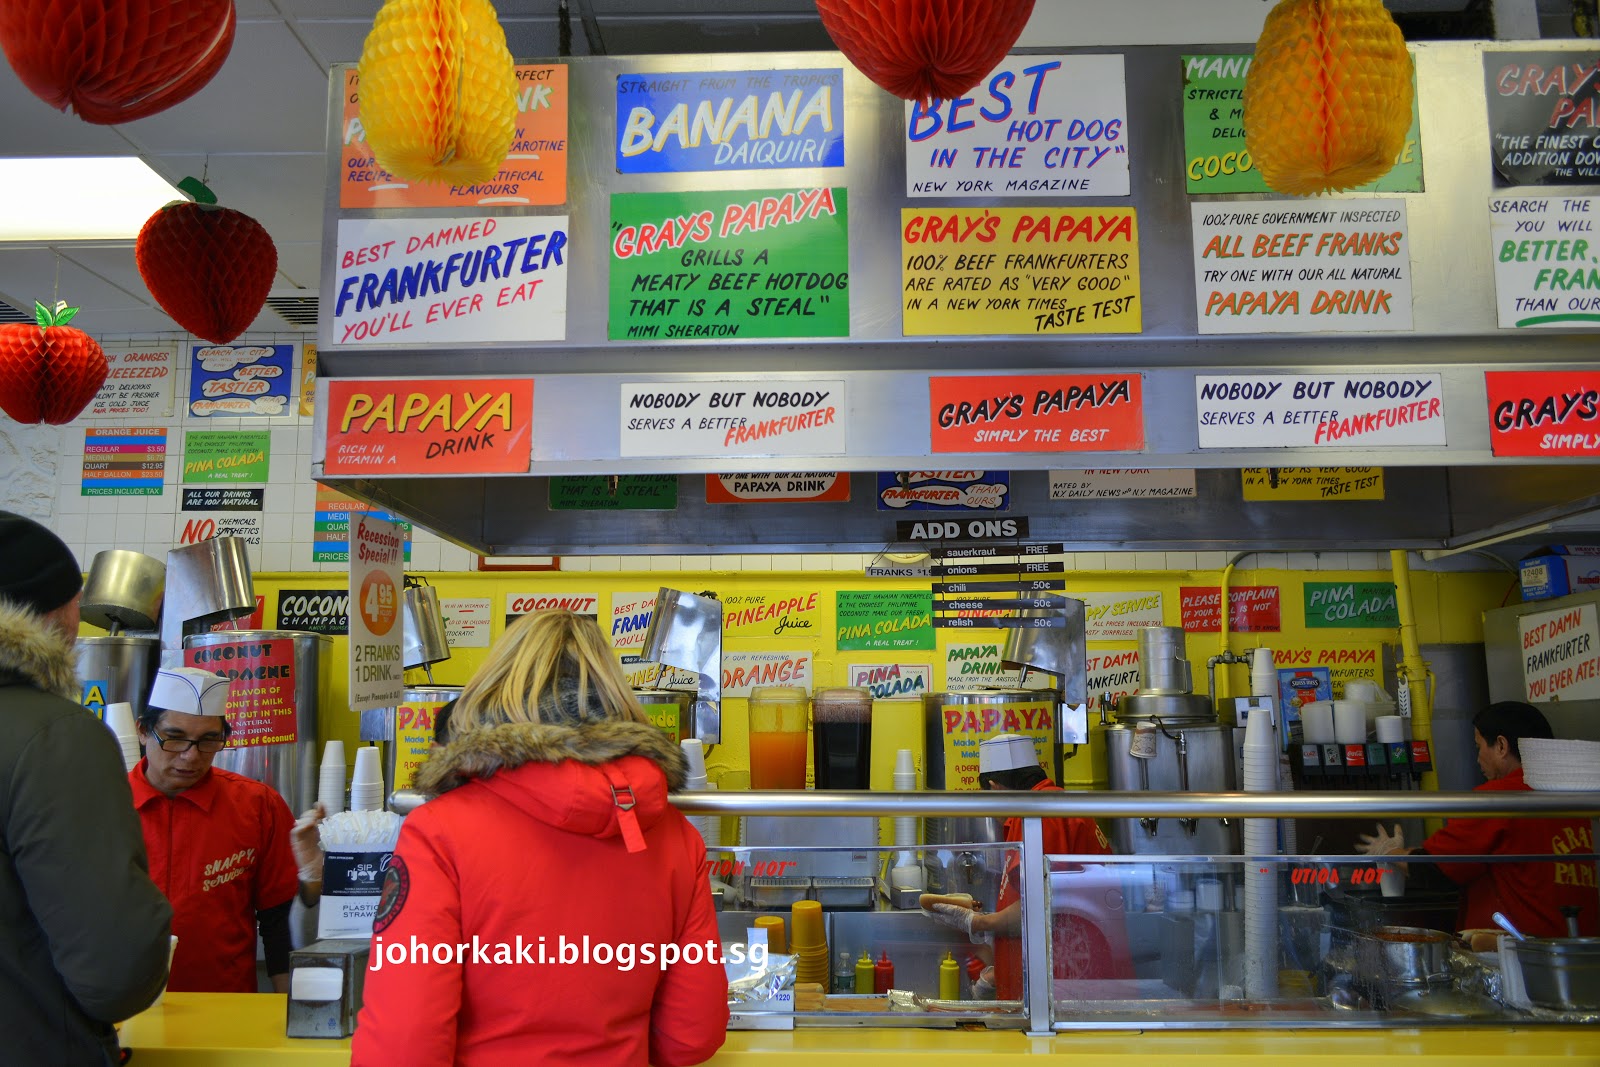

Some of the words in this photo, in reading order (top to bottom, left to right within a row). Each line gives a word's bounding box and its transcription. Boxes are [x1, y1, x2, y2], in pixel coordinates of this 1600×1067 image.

[619, 79, 690, 94] STRAIGHT
[700, 78, 736, 89] FROM
[749, 76, 772, 88] THE
[784, 74, 838, 86] TROPICS
[620, 86, 833, 157] BANANA
[1007, 119, 1062, 142] HOT
[1067, 119, 1122, 141] DOG
[1536, 135, 1588, 149] FINEST
[714, 139, 826, 165] DAIQUIRI
[930, 149, 958, 168] IN
[973, 147, 1026, 168] THE
[1044, 146, 1126, 168] CITY"
[1502, 152, 1569, 165] ADDITION
[913, 182, 947, 192] NEW
[956, 181, 993, 192] YORK
[1005, 179, 1090, 191] MAGAZINE
[720, 187, 836, 237] PAPAYA
[1490, 200, 1549, 213] SEARCH
[904, 210, 1001, 243] GRAY'S
[1011, 215, 1132, 243] PAPAYA
[1203, 213, 1229, 226] 100%
[1230, 214, 1259, 225] PURE
[1262, 212, 1337, 224] GOVERNMENT
[1339, 211, 1400, 223] INSPECTED
[342, 241, 396, 269] BEST
[406, 219, 497, 254] DAMNED
[1202, 235, 1244, 258] ALL
[1252, 233, 1313, 258] BEEF
[1315, 232, 1402, 256] FRANKS
[681, 249, 744, 267] GRILLS
[754, 249, 769, 265] A
[907, 255, 948, 271] 100%
[954, 254, 997, 271] BEEF
[1004, 254, 1129, 270] FRANKFURTERS
[334, 231, 567, 317] FRANKFURTER
[631, 274, 700, 292] MEATY
[708, 273, 760, 290] BEEF
[766, 273, 848, 290] HOTDOG
[905, 277, 936, 291] ARE
[943, 277, 992, 291] RATED
[1000, 278, 1019, 291] AS
[1026, 275, 1071, 291] "VERY
[1077, 275, 1129, 291] GOOD"
[1204, 271, 1228, 283] TRY
[1230, 270, 1257, 282] ONE
[1261, 270, 1292, 281] WITH
[1298, 269, 1324, 281] OUR
[1326, 269, 1346, 280] ALL
[1351, 268, 1402, 280] NATURAL
[341, 311, 413, 343] YOU'LL
[426, 293, 483, 323] EVER
[498, 280, 544, 306] EAT
[629, 300, 680, 316] THAT
[688, 300, 706, 316] IS
[716, 300, 731, 316] A
[746, 295, 830, 316] STEAL"
[907, 299, 922, 310] IN
[927, 299, 939, 310] A
[947, 299, 981, 310] NEW
[985, 299, 1020, 310] YORK
[1027, 299, 1067, 310] TIMES
[1205, 291, 1299, 316] PAPAYA
[1310, 289, 1393, 315] DRINK
[1034, 306, 1086, 332] TASTE
[1093, 296, 1135, 320] TEST
[627, 325, 659, 336] MIMI
[668, 325, 739, 336] SHERATON
[124, 353, 169, 362] ORANGES
[240, 368, 278, 376] BETTER
[209, 382, 264, 392] TASTIER
[630, 393, 700, 409] NOBODY
[709, 392, 745, 408] BUT
[753, 391, 830, 407] NOBODY
[1032, 379, 1131, 416] PAPAYA
[340, 392, 512, 433] PAPAYA
[628, 418, 675, 430] SERVES
[681, 420, 691, 429] A
[699, 418, 747, 430] BETTER
[724, 407, 836, 447] FRANKFURTER
[974, 430, 1027, 442] SIMPLY
[1034, 429, 1061, 442] THE
[1070, 429, 1109, 442] BEST
[338, 445, 367, 453] RICH
[372, 445, 384, 453] IN
[426, 432, 495, 459] DRINK
[185, 460, 214, 474] PINA
[217, 451, 264, 468] COLADA
[338, 456, 383, 464] VITAMIN
[388, 455, 397, 464] A
[734, 482, 780, 493] PAPAYA
[787, 481, 825, 491] DRINK
[882, 490, 960, 500] FRANKFURTER
[1068, 489, 1093, 497] DAILY
[1096, 489, 1120, 497] NEWS
[1321, 484, 1351, 498] TASTE
[1355, 476, 1379, 489] TEST
[358, 523, 399, 548] Recession
[910, 522, 960, 539] ADD
[968, 520, 1017, 537] ONS
[947, 548, 996, 557] sauerkraut
[1026, 545, 1048, 554] FREE
[948, 566, 977, 574] onions
[1026, 563, 1049, 572] FREE
[948, 584, 966, 592] chili
[1310, 585, 1354, 607] PINA
[948, 601, 982, 609] cheese
[1183, 594, 1220, 607] PLEASE
[1324, 595, 1396, 621] COLADA
[726, 593, 819, 630] PINEAPPLE
[774, 616, 812, 634] Juice
[838, 628, 871, 641] PINA
[875, 614, 931, 634] COLADA
[948, 618, 973, 627] relish
[1524, 624, 1546, 649] BEST
[1550, 609, 1581, 638] DAMN
[356, 647, 362, 661] 2
[364, 646, 400, 662] FRANKS
[948, 645, 997, 662] PAPAYA
[1527, 634, 1590, 673] FRANKFURTER
[356, 668, 360, 682] 1
[362, 665, 392, 682] DRINK
[232, 687, 266, 697] FLAVOR
[1529, 680, 1546, 699] YOU
[1550, 669, 1573, 692] EVER
[944, 707, 1052, 733] PAPAYA
